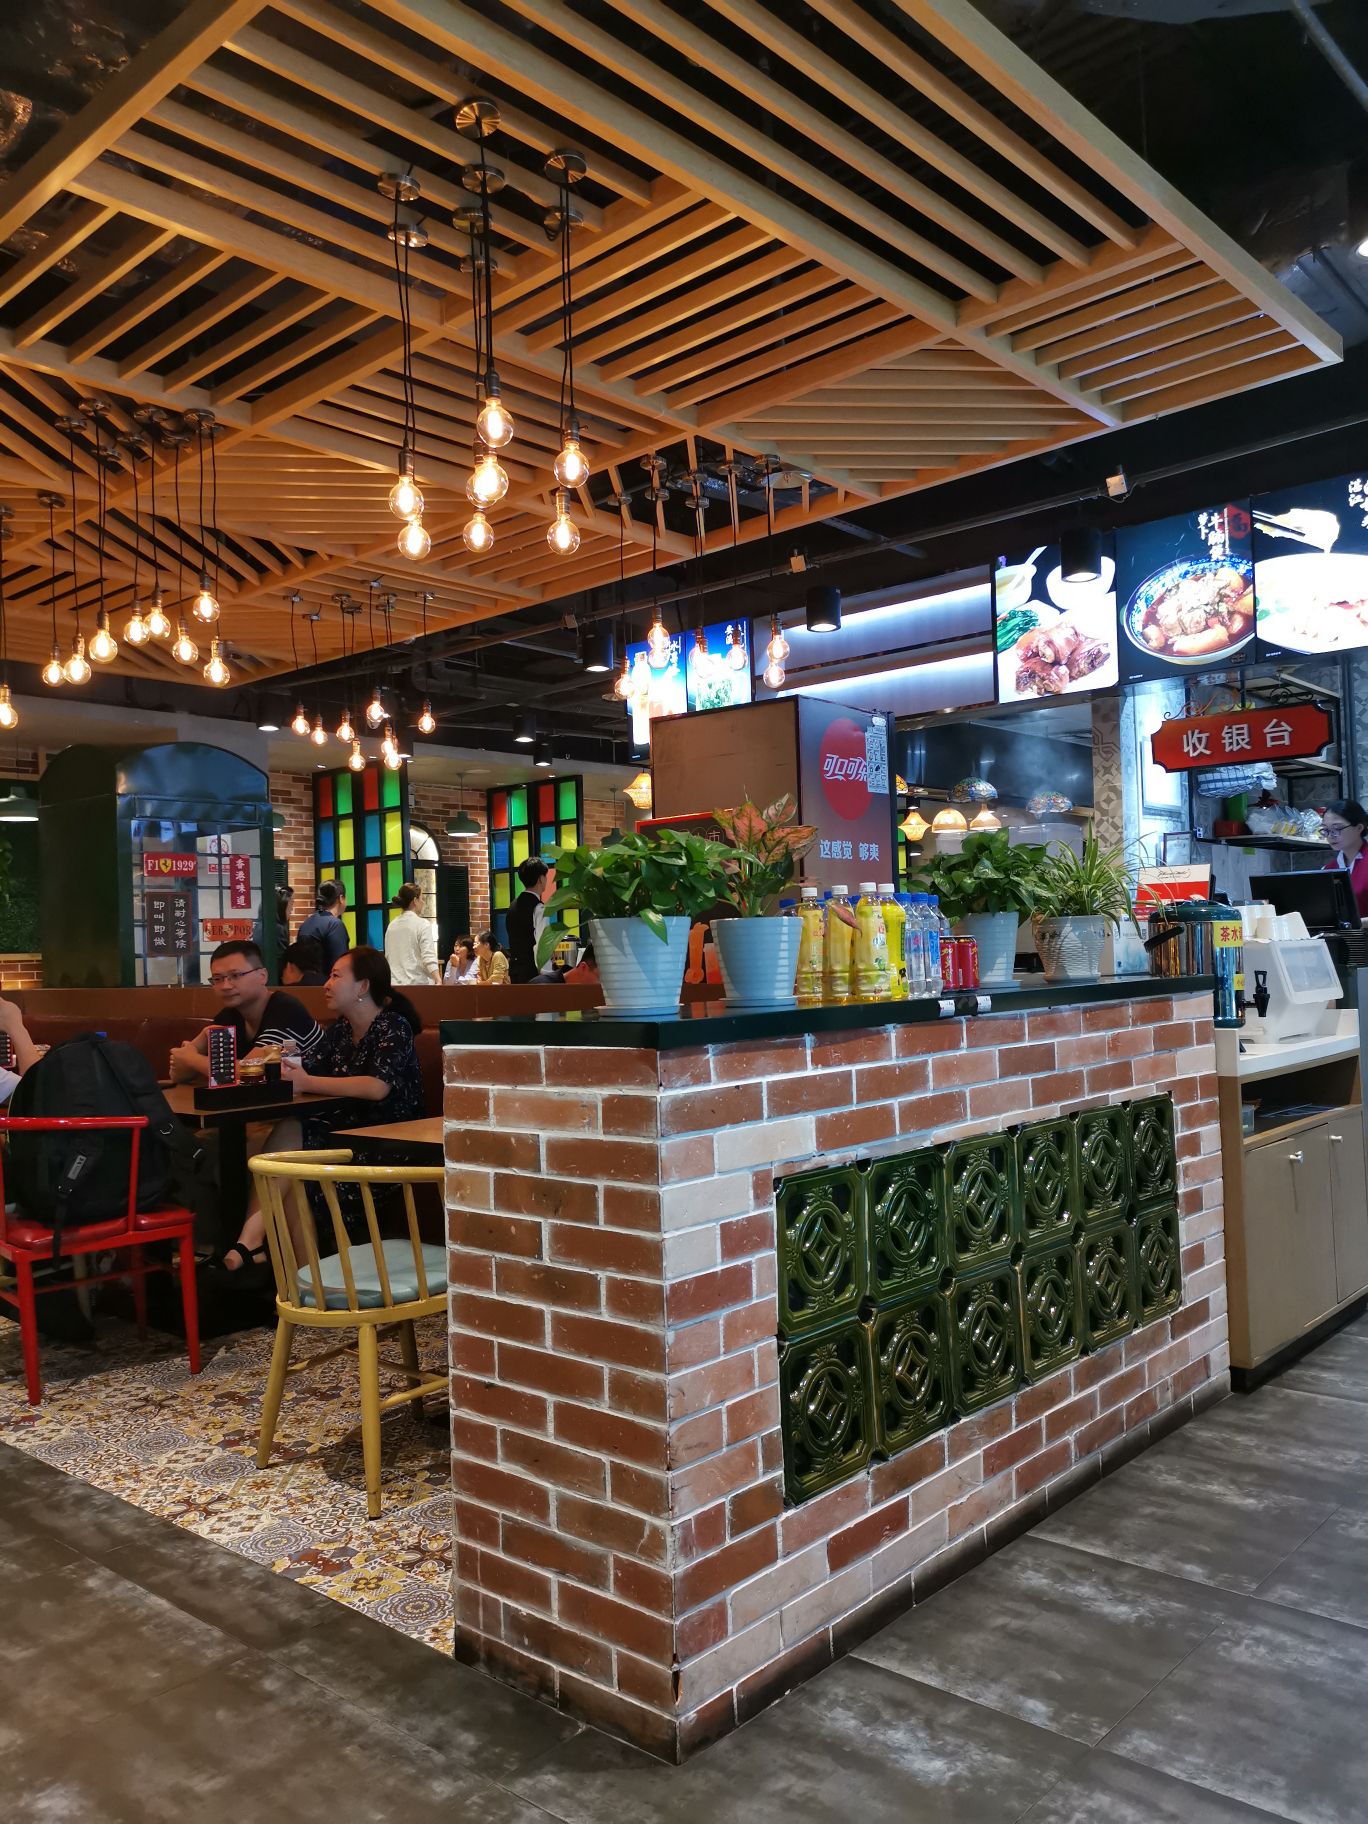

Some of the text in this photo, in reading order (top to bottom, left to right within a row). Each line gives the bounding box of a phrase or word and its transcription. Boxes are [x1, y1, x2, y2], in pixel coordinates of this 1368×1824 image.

[1182, 718, 1294, 758] 收银台
[147, 859, 159, 871] F1
[172, 858, 195, 871] 1929
[819, 839, 880, 862] 这感觉 够爽
[235, 858, 246, 907] 香港味道
[153, 900, 167, 947] 即叫即做
[174, 897, 188, 949] 请耐心等候
